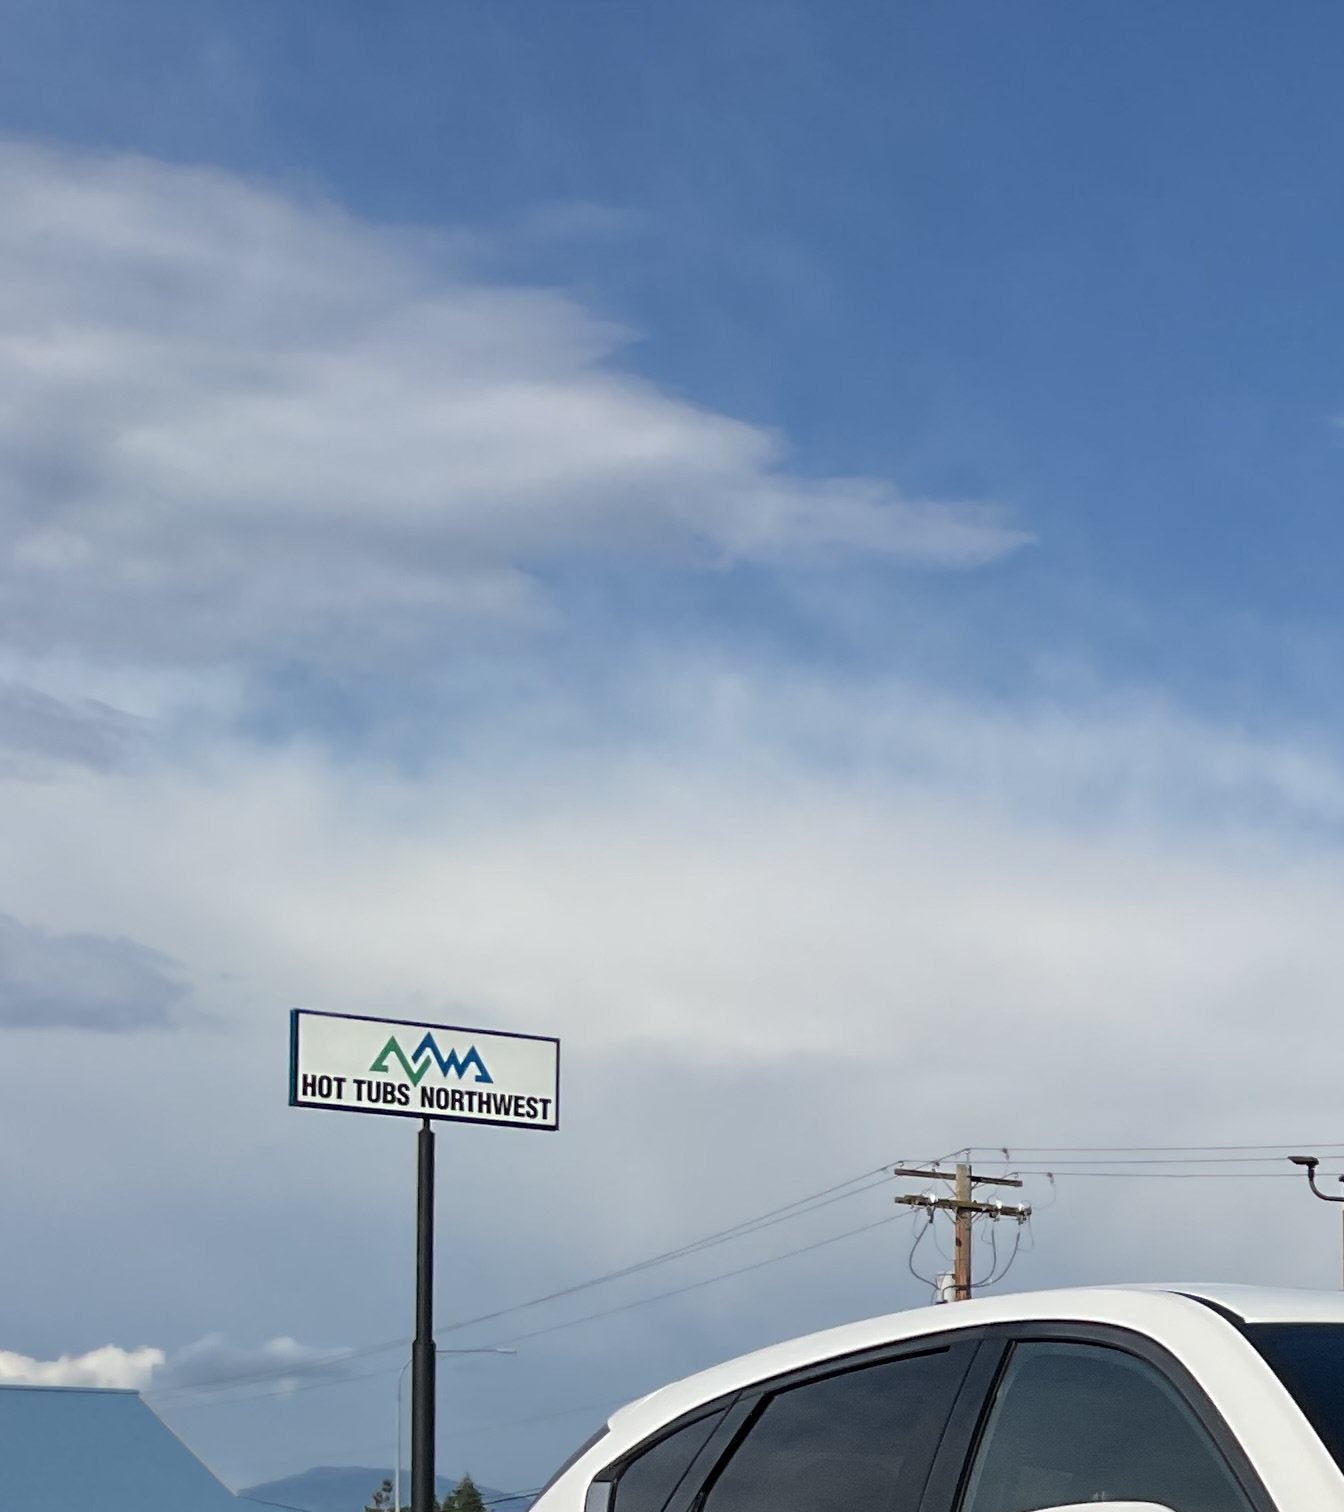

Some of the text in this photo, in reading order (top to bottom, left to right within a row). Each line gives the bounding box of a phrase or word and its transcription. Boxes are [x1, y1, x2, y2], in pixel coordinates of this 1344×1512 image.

[302, 1073, 552, 1120] HOT TUBS NORTHWEST
